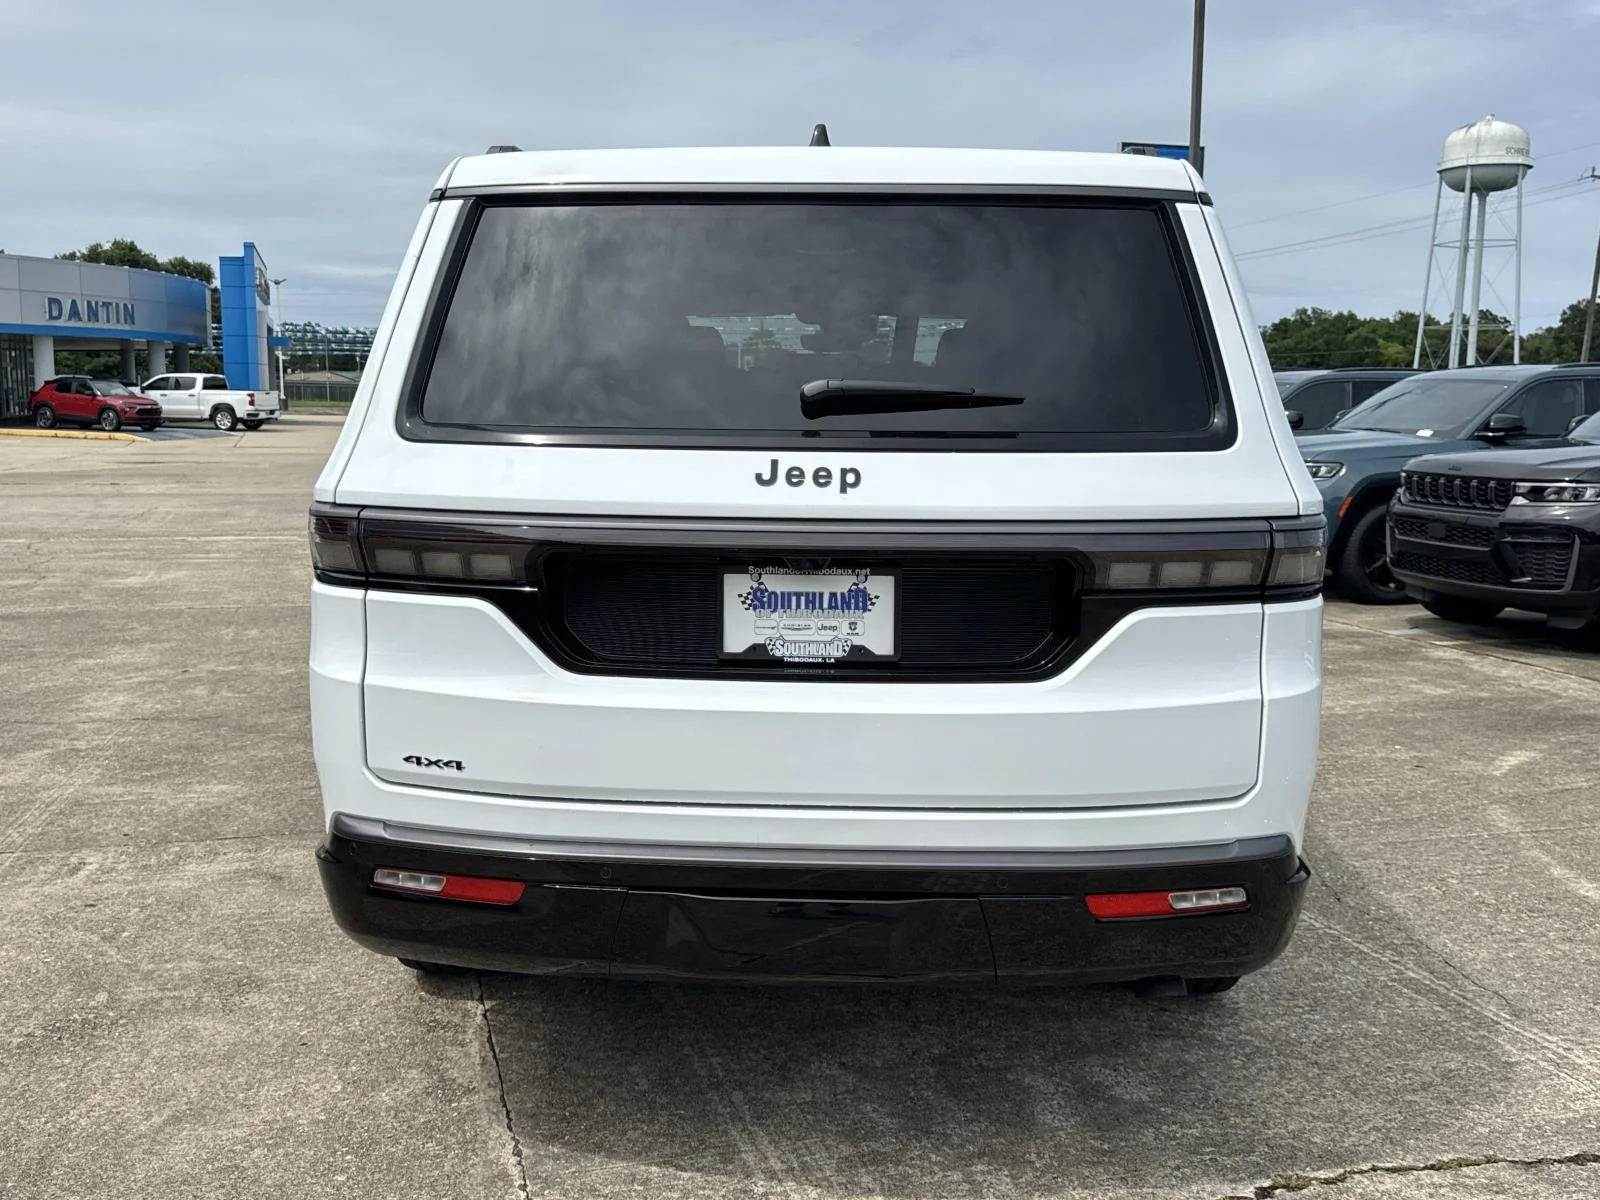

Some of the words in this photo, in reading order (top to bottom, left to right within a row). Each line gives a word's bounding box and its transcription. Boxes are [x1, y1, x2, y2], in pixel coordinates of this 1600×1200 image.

[46, 297, 136, 325] DANTIN
[755, 459, 861, 494] Jeep
[752, 586, 868, 613] SOUTHLAND
[817, 623, 838, 632] Jeep
[774, 639, 843, 657] SOUTHLAND
[402, 755, 466, 771] 4x4
